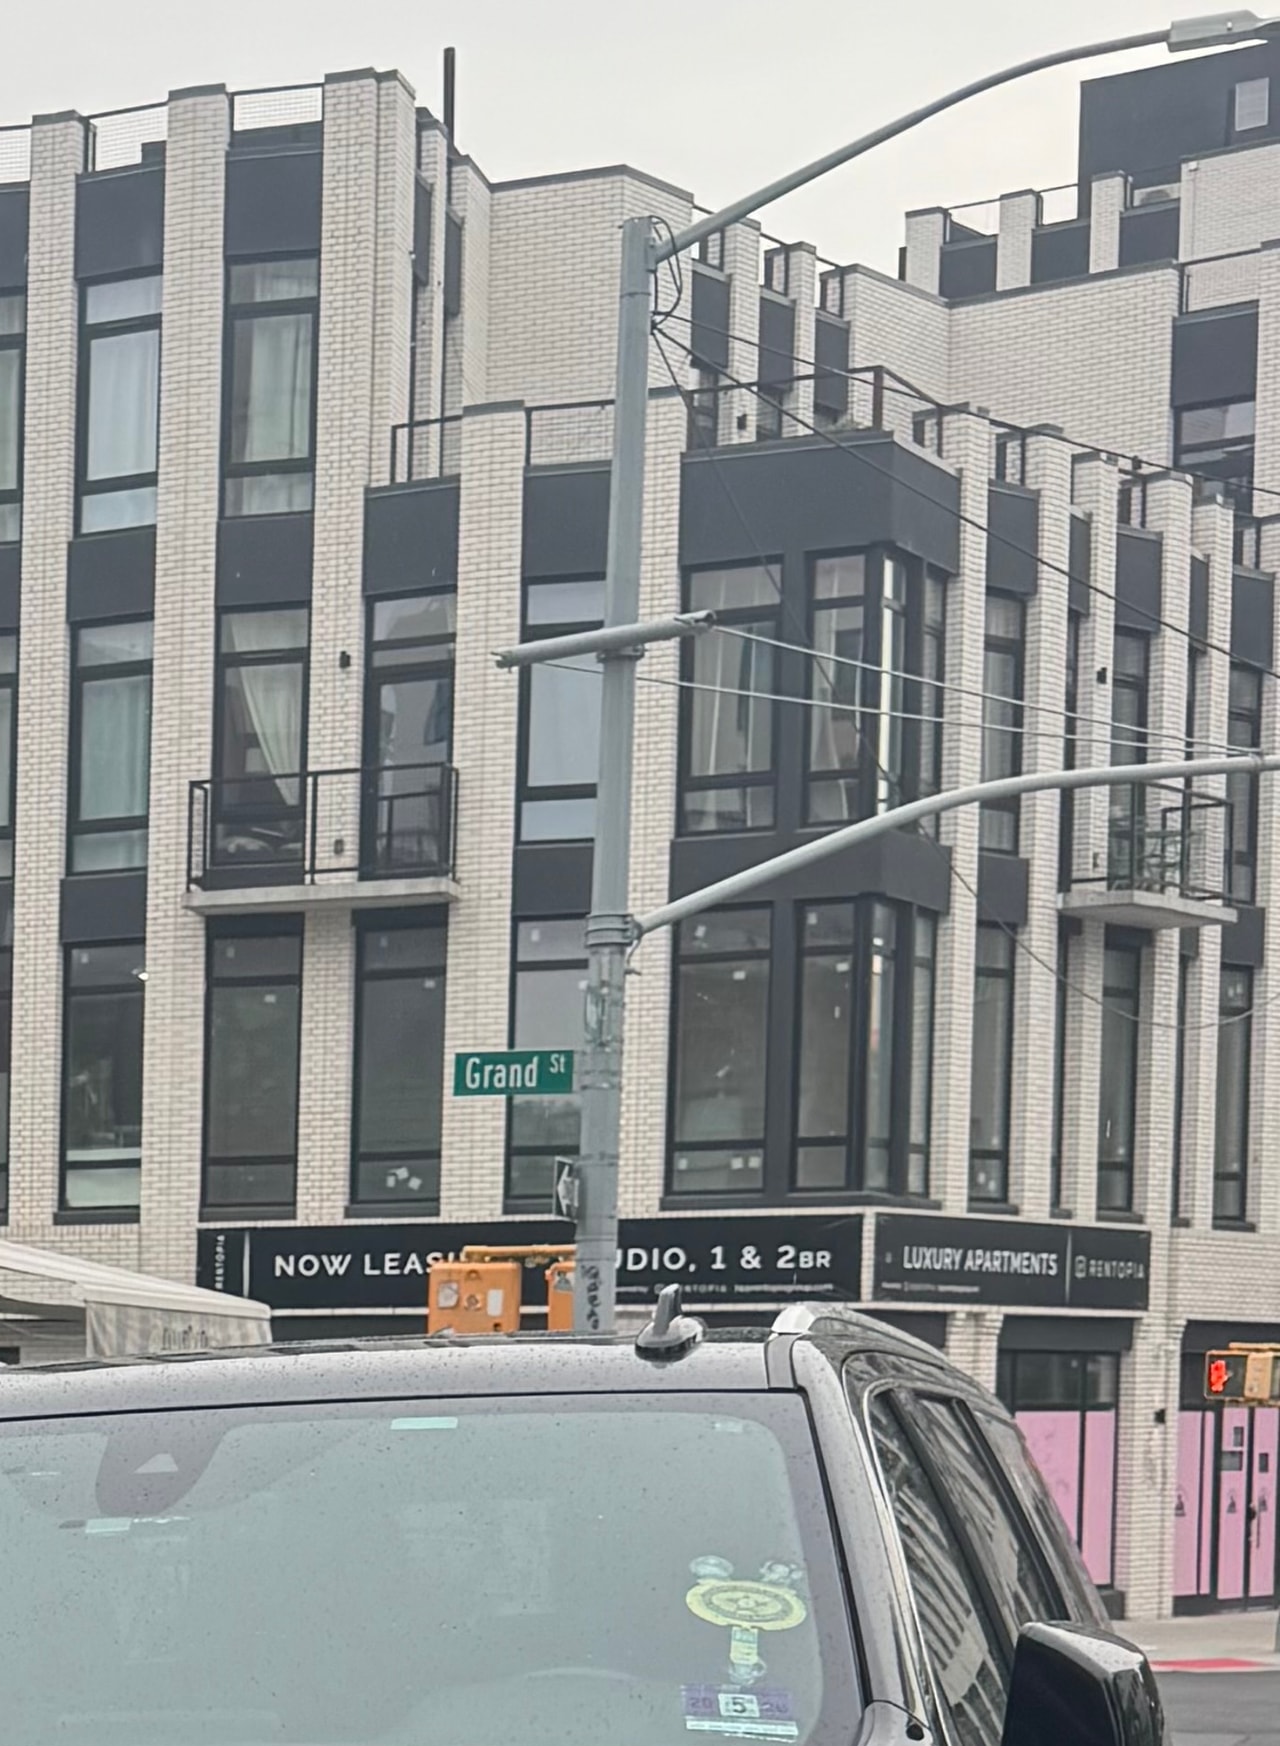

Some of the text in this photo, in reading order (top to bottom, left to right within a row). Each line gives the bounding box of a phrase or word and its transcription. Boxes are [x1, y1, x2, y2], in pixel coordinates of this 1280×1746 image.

[465, 1053, 566, 1089] Grand St
[275, 1253, 351, 1276] NOW
[711, 1246, 727, 1270] 1
[740, 1245, 762, 1269] &
[777, 1245, 831, 1269] 2BR
[903, 1246, 963, 1270] LUXURY
[964, 1249, 1058, 1276] APARTMENTS
[1090, 1259, 1144, 1279] RENTOPIA
